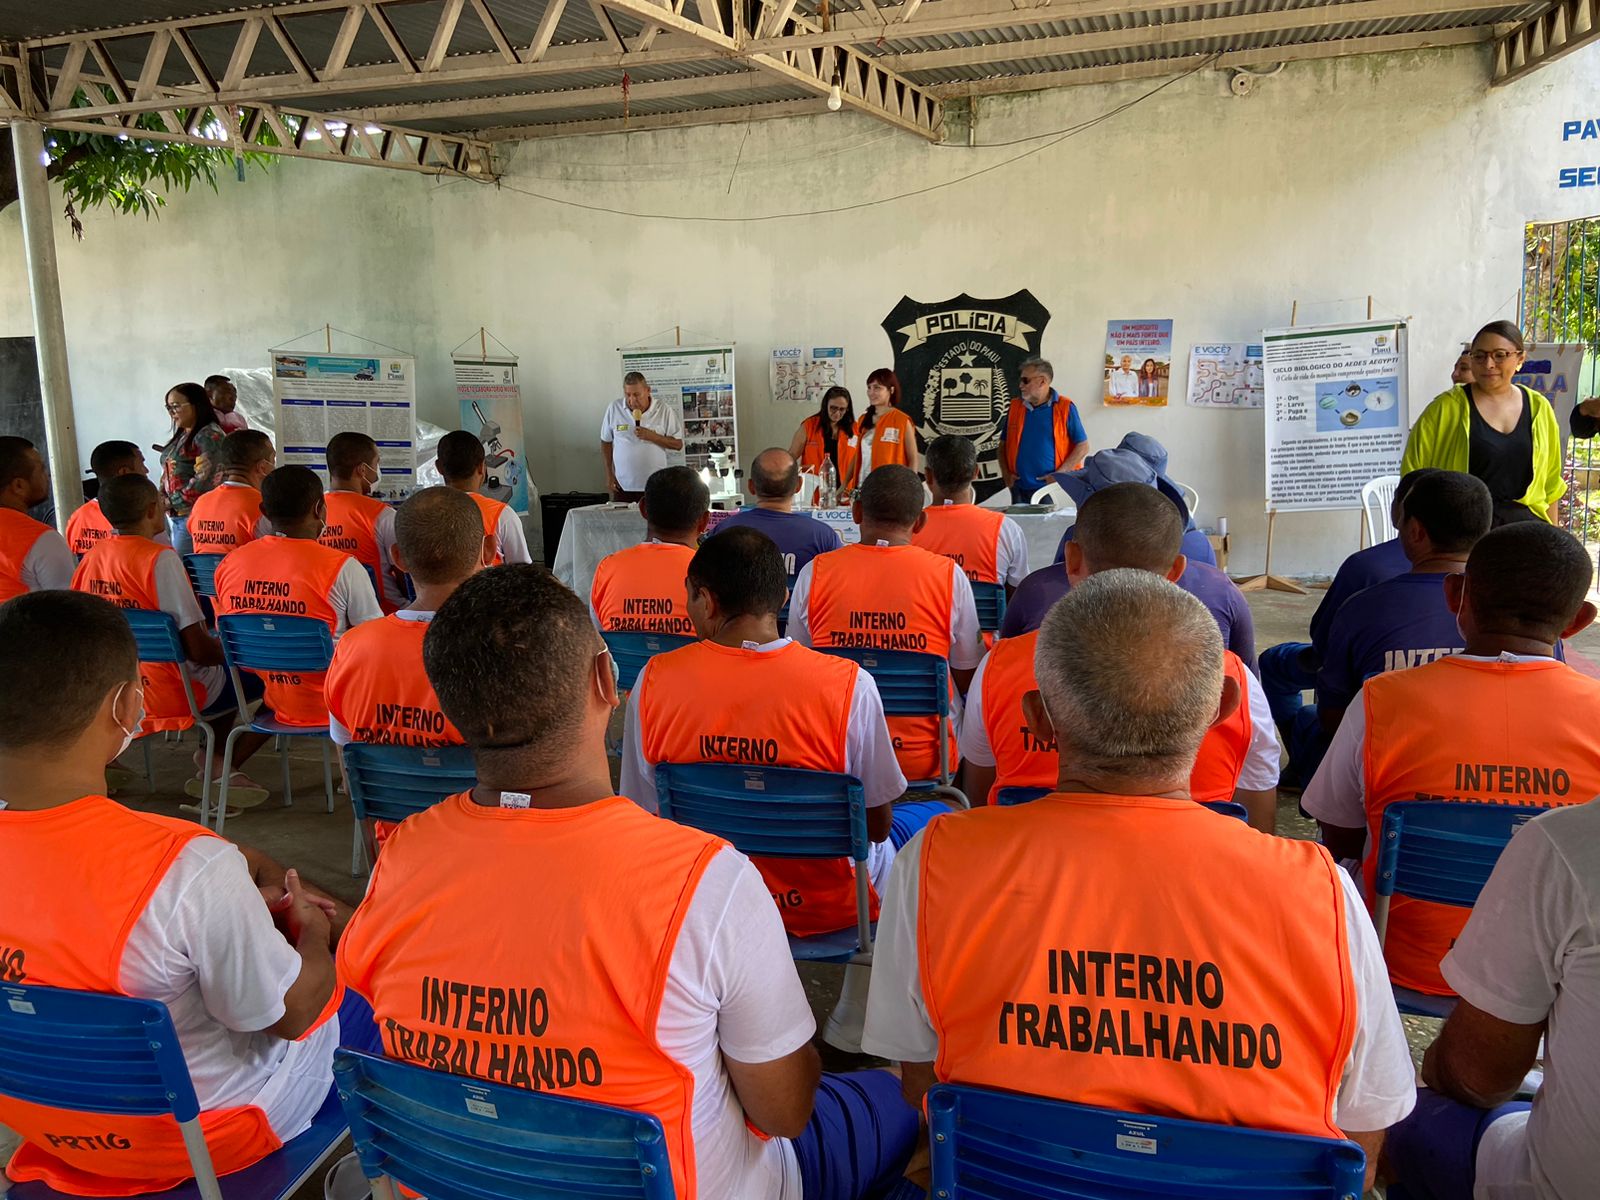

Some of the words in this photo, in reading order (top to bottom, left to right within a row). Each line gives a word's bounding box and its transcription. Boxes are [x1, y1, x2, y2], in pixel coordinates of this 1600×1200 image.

[1562, 119, 1600, 142] PA
[1558, 166, 1600, 188] SE
[926, 311, 1006, 334] POLÍCIA
[939, 341, 967, 368] ESTADO
[969, 340, 981, 353] DO
[1294, 363, 1331, 372] BIOLÓGICO
[1369, 358, 1398, 366] AEGYPTI
[81, 528, 108, 539] INTERNO
[198, 520, 225, 532] INTERNO
[244, 580, 290, 597] INTERNO
[230, 596, 306, 615] TRABALHANDO
[624, 598, 673, 614] INTERNO
[610, 616, 692, 633] TRABALHANDO
[849, 611, 906, 630] INTERNO
[830, 631, 927, 650] TRABALHANDO
[376, 704, 445, 734] INTERNO
[699, 735, 778, 763] INTERNO
[1455, 763, 1570, 796] INTERNO
[1048, 948, 1224, 1010] INTERNO
[420, 976, 549, 1038] INTERNO
[998, 1001, 1282, 1070] TRABALHANDO
[385, 1018, 603, 1090] TRABALHANDO
[43, 1132, 132, 1151] PRTIG
